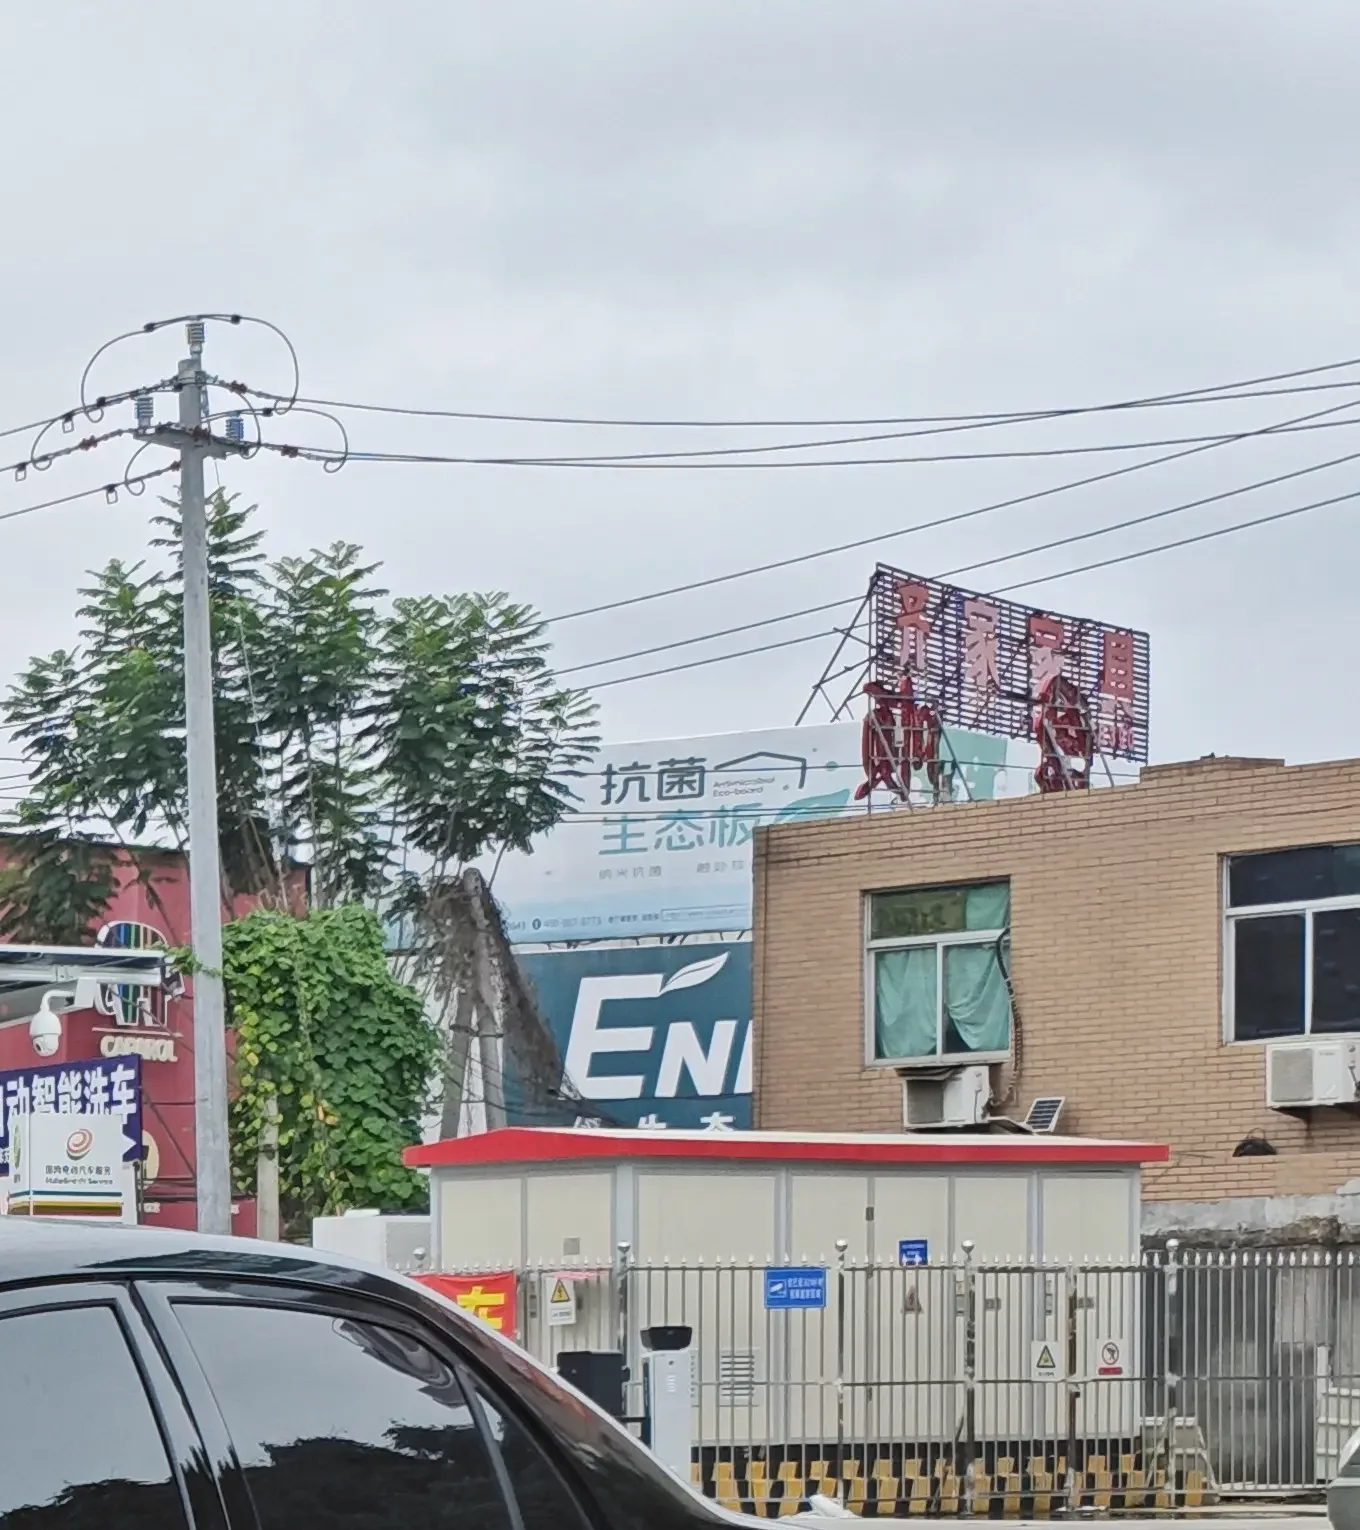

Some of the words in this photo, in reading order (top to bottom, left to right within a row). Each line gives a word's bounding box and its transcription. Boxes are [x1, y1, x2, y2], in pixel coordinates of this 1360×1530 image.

[600, 757, 708, 805] 抗菌
[598, 803, 764, 856] 生态板
